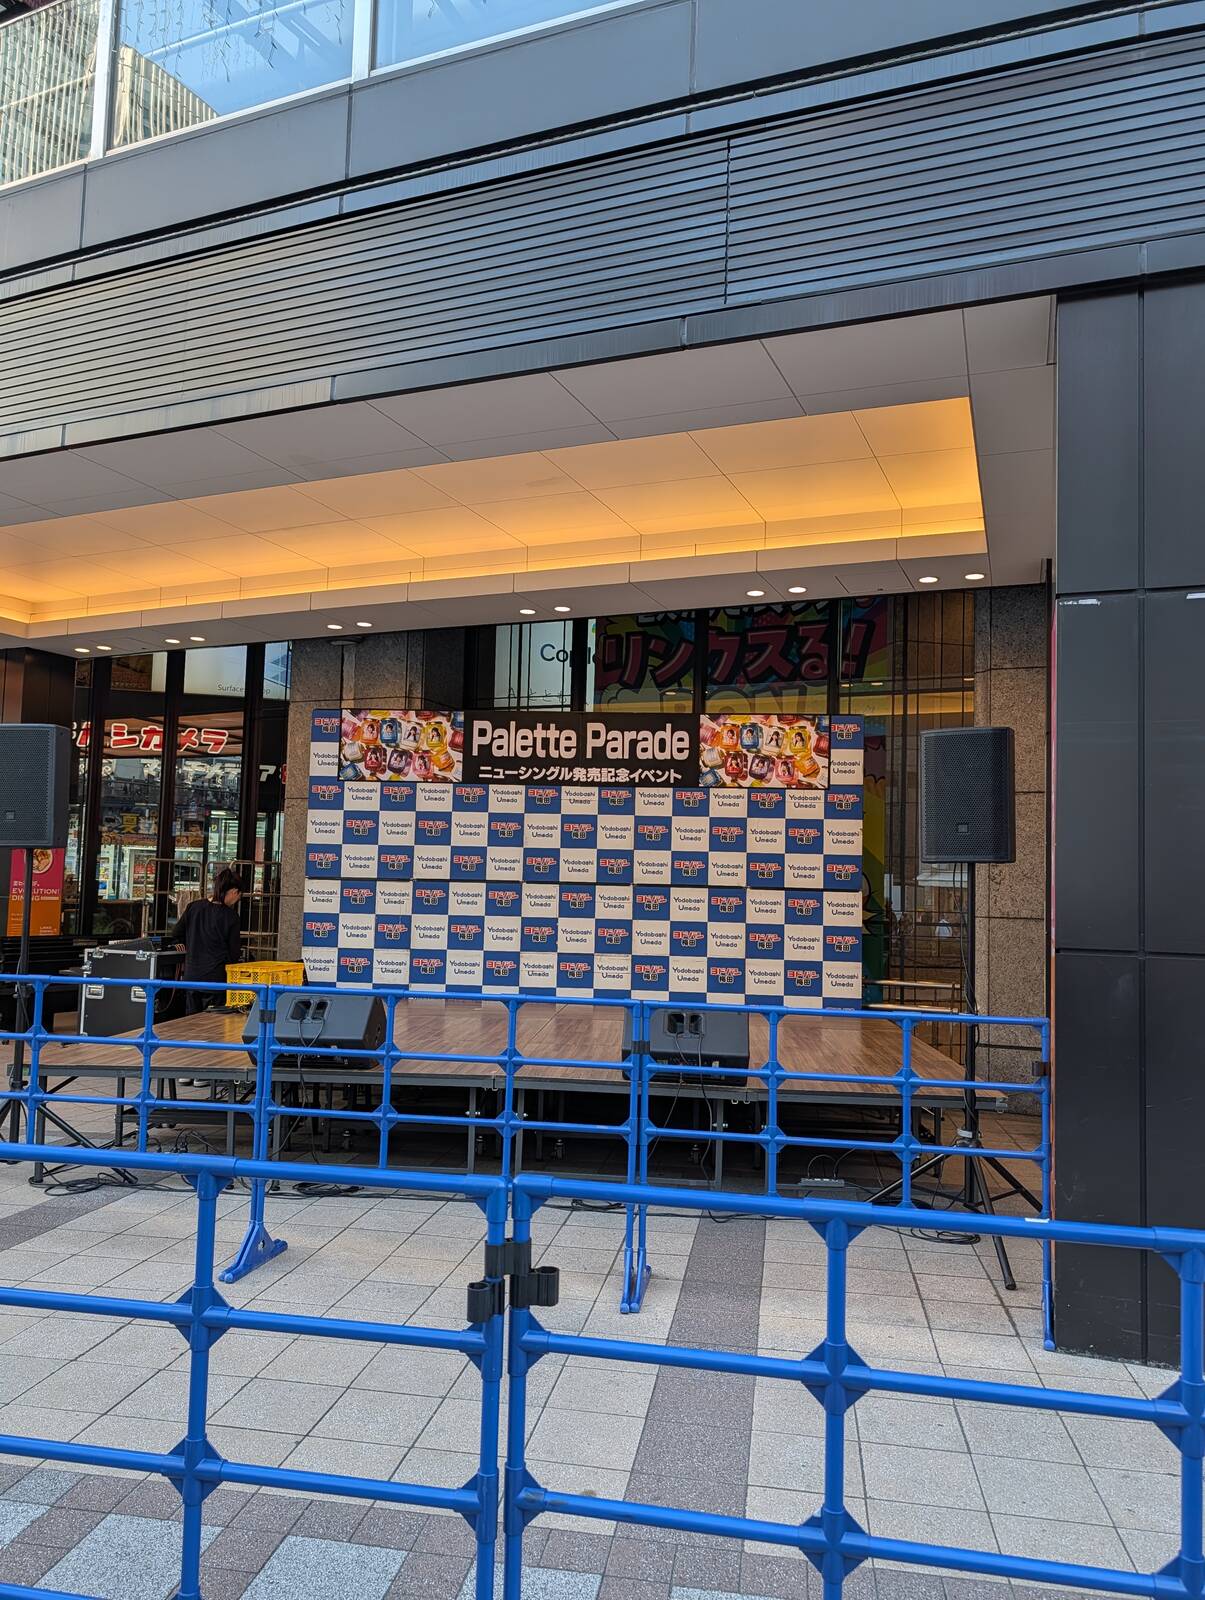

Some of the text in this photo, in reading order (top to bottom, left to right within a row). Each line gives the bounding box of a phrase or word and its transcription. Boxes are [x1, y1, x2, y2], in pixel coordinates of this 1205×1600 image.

[472, 720, 690, 761] Palette Parade
[479, 766, 682, 784] ニューシングル発売記念イベント
[600, 824, 631, 832] Yodobashi
[827, 829, 859, 837] Yodobashi
[749, 898, 781, 906] Yodobashi
[826, 900, 858, 908] Yodobashi
[672, 966, 704, 974] Yodobashi
